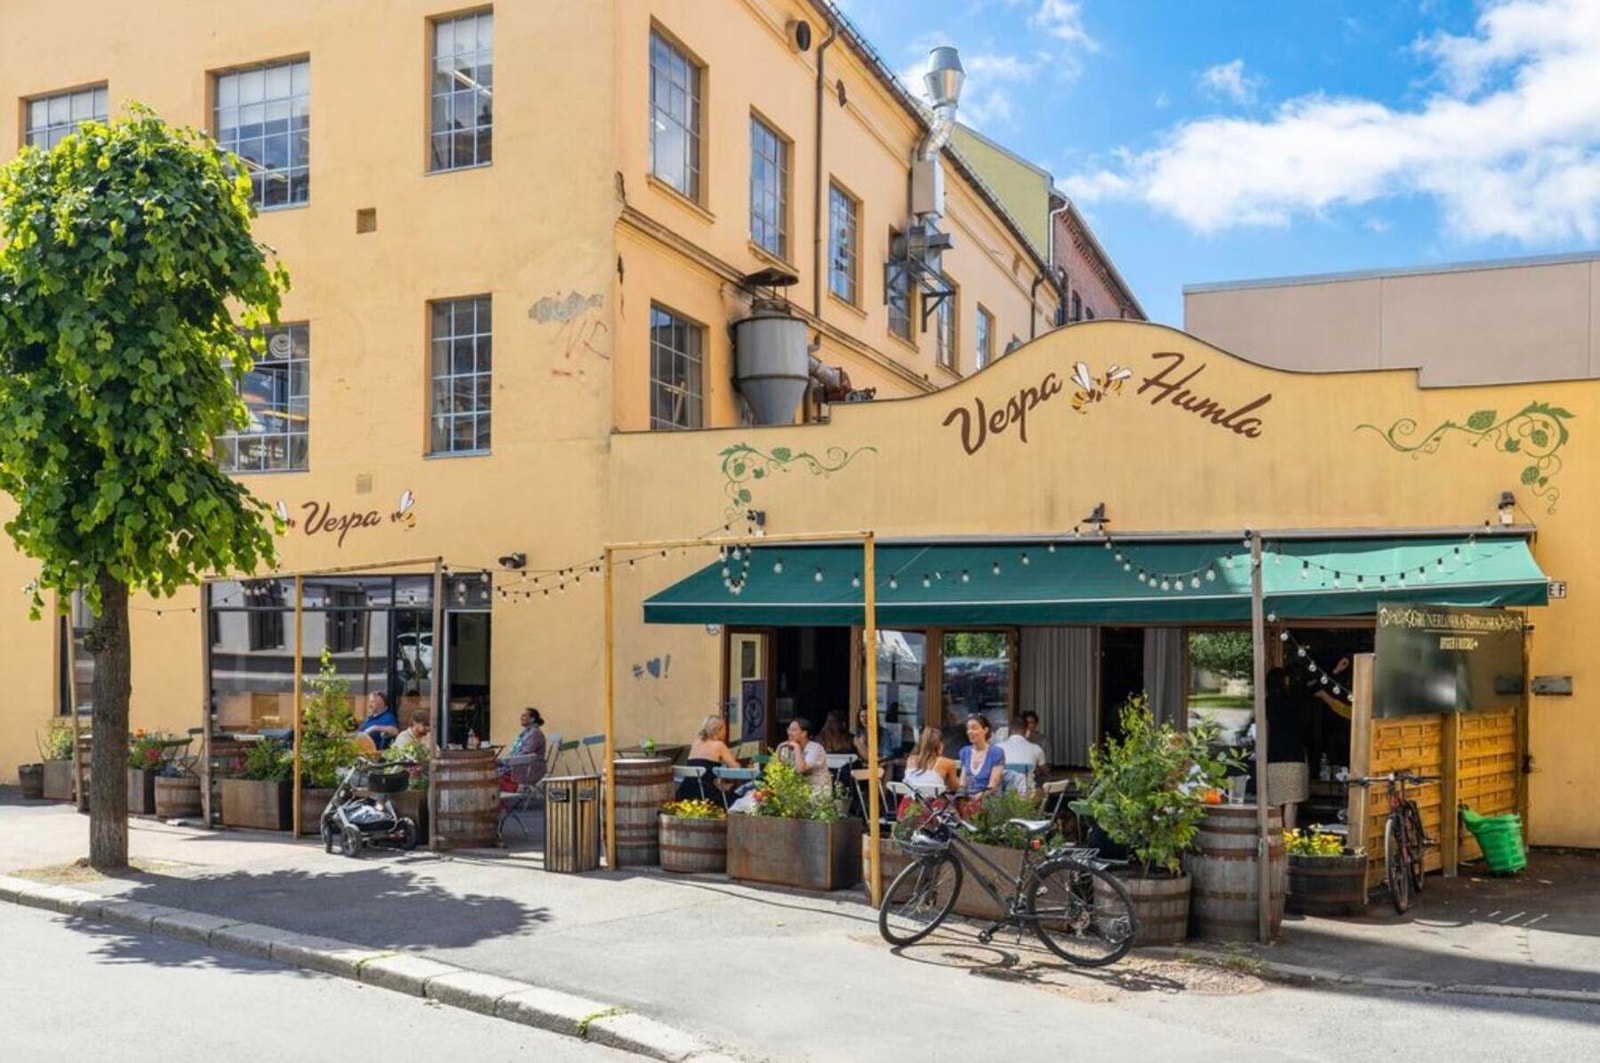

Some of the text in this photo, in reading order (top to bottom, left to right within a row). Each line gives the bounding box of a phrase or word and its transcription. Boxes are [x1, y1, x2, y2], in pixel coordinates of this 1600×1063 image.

[942, 352, 1272, 456] Vespa Humla
[301, 501, 381, 548] Vespa
